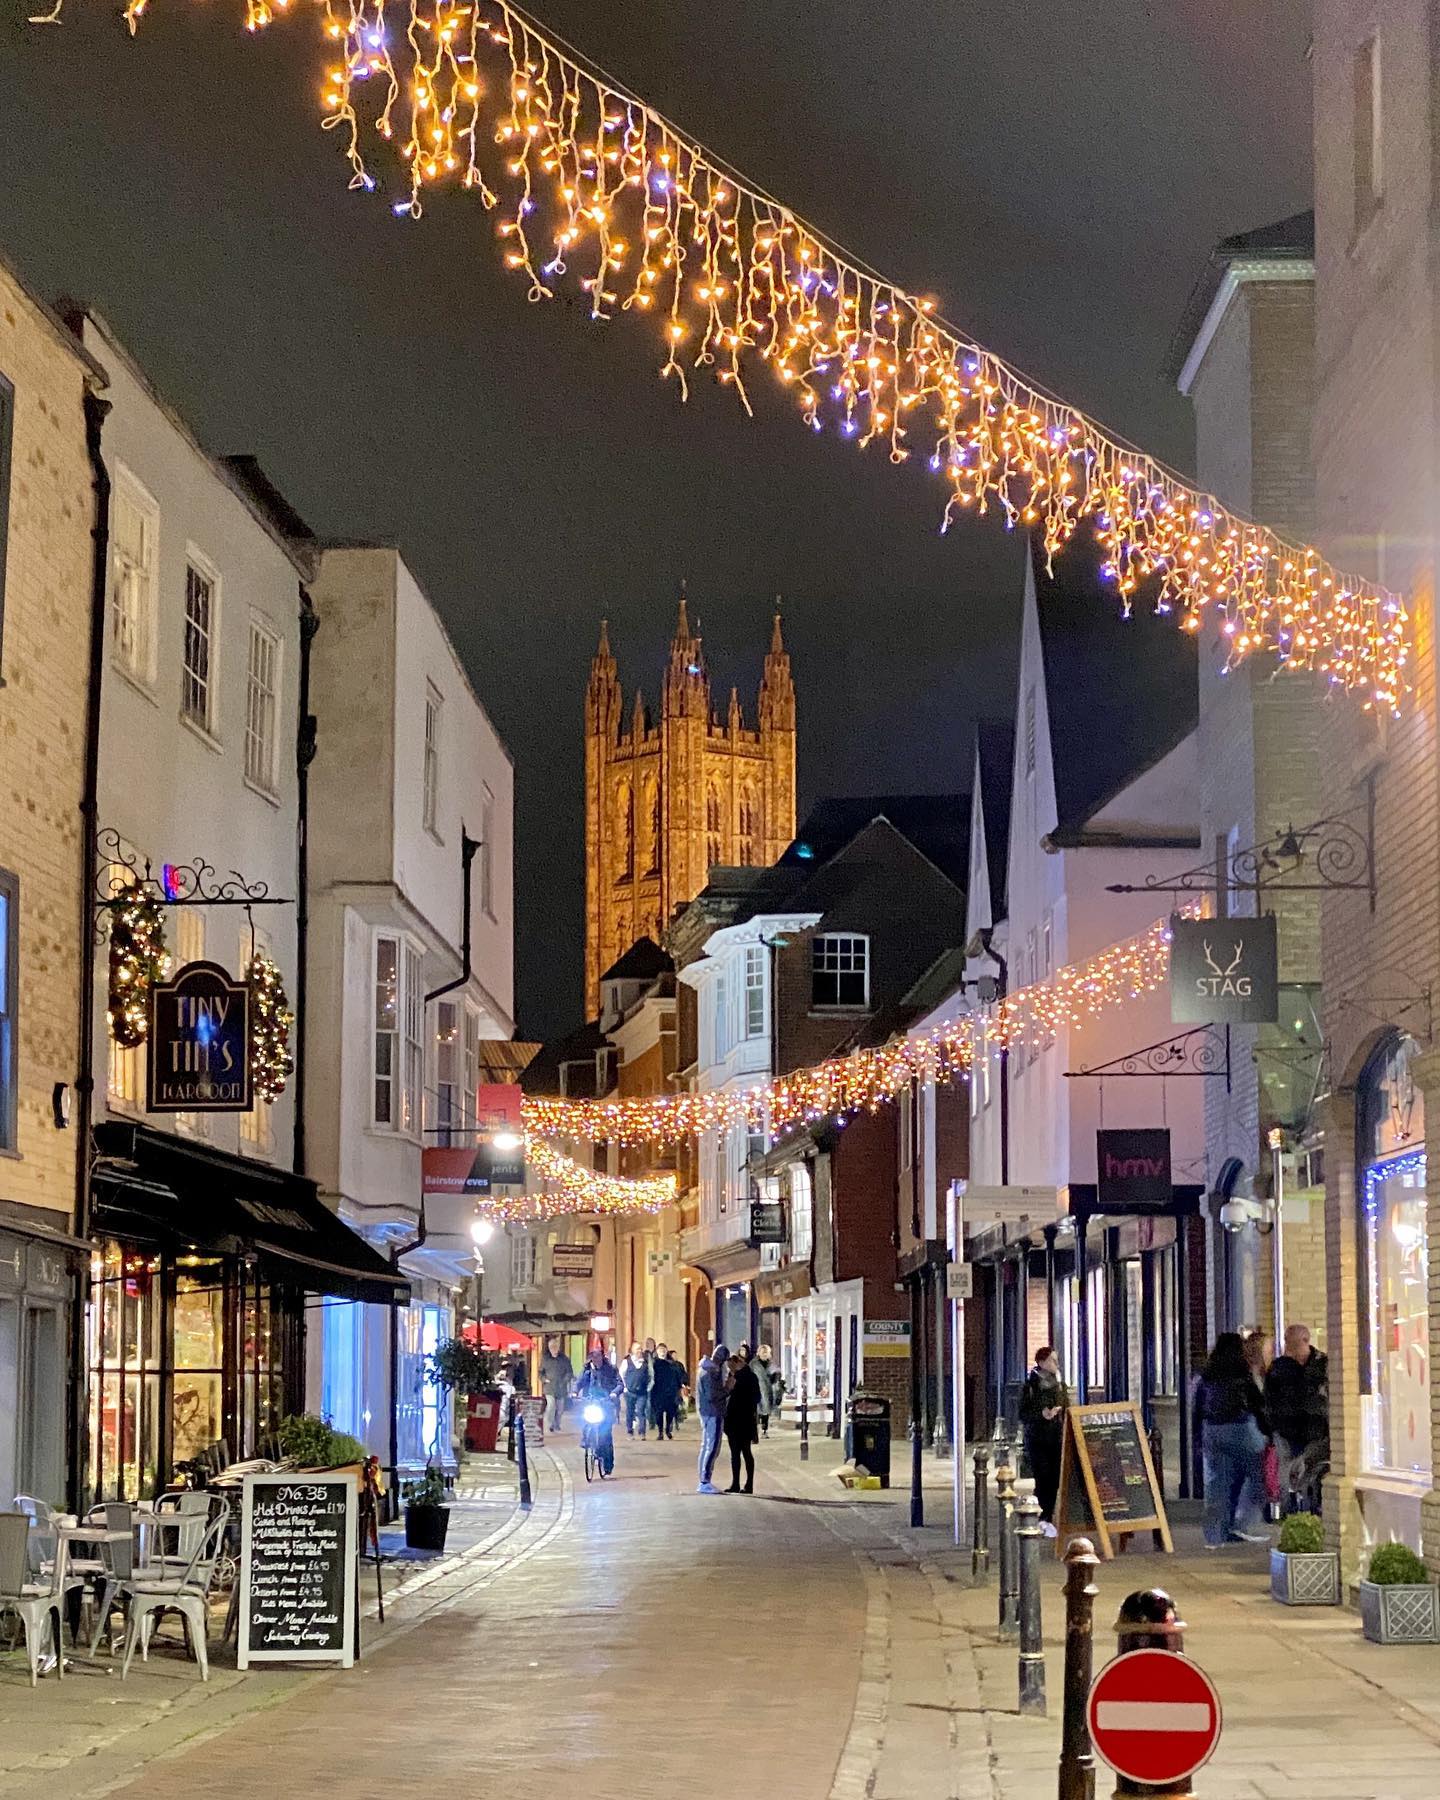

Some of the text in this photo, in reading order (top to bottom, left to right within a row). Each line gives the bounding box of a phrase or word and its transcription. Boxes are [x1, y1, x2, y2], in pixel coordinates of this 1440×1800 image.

[1196, 977, 1252, 997] STAG
[173, 996, 230, 1029] TINY
[1105, 1153, 1164, 1178] hmv
[306, 1486, 328, 1500] 35
[254, 1502, 275, 1516] Hot
[275, 1502, 309, 1515] Drinks
[251, 1573, 279, 1584] Lunch
